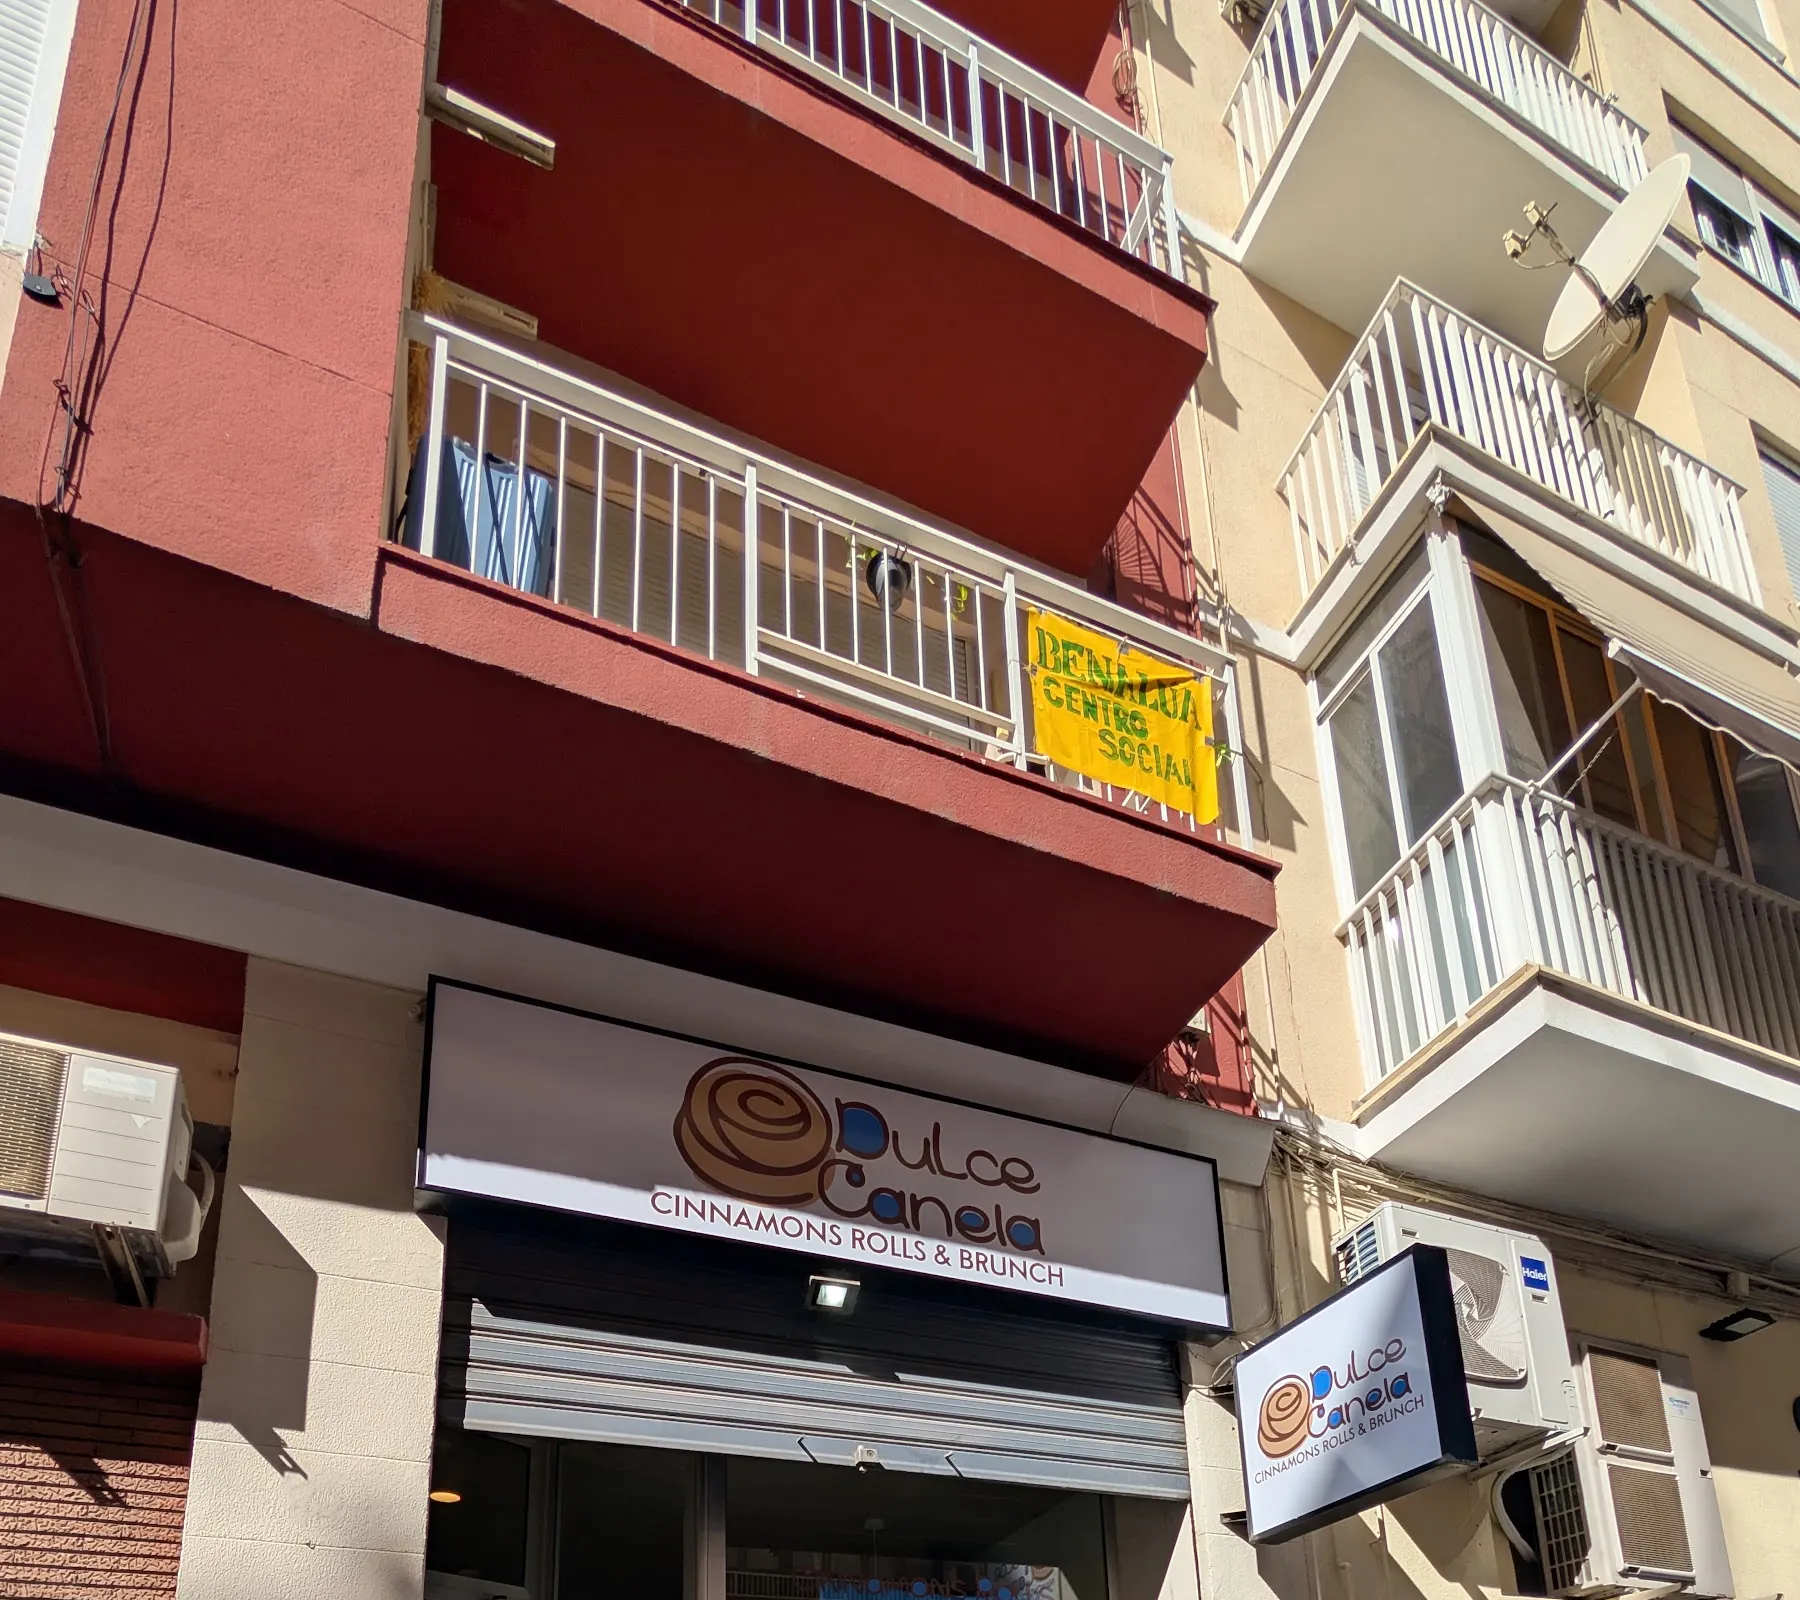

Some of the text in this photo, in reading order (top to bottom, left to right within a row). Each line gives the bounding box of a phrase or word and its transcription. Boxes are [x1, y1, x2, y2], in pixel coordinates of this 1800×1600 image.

[1035, 626, 1202, 731] BENALUA
[1043, 676, 1149, 741] CENTRO
[1098, 728, 1196, 791] SOCIAL
[650, 1191, 1064, 1287] CINNAMONS ROLLS & BRUNCH
[818, 1158, 1046, 1256] Canela
[1522, 1266, 1547, 1281] Haier
[1254, 1394, 1425, 1485] CINNAMONS ROLLS & BRUNCH
[1306, 1372, 1413, 1439] Canela
